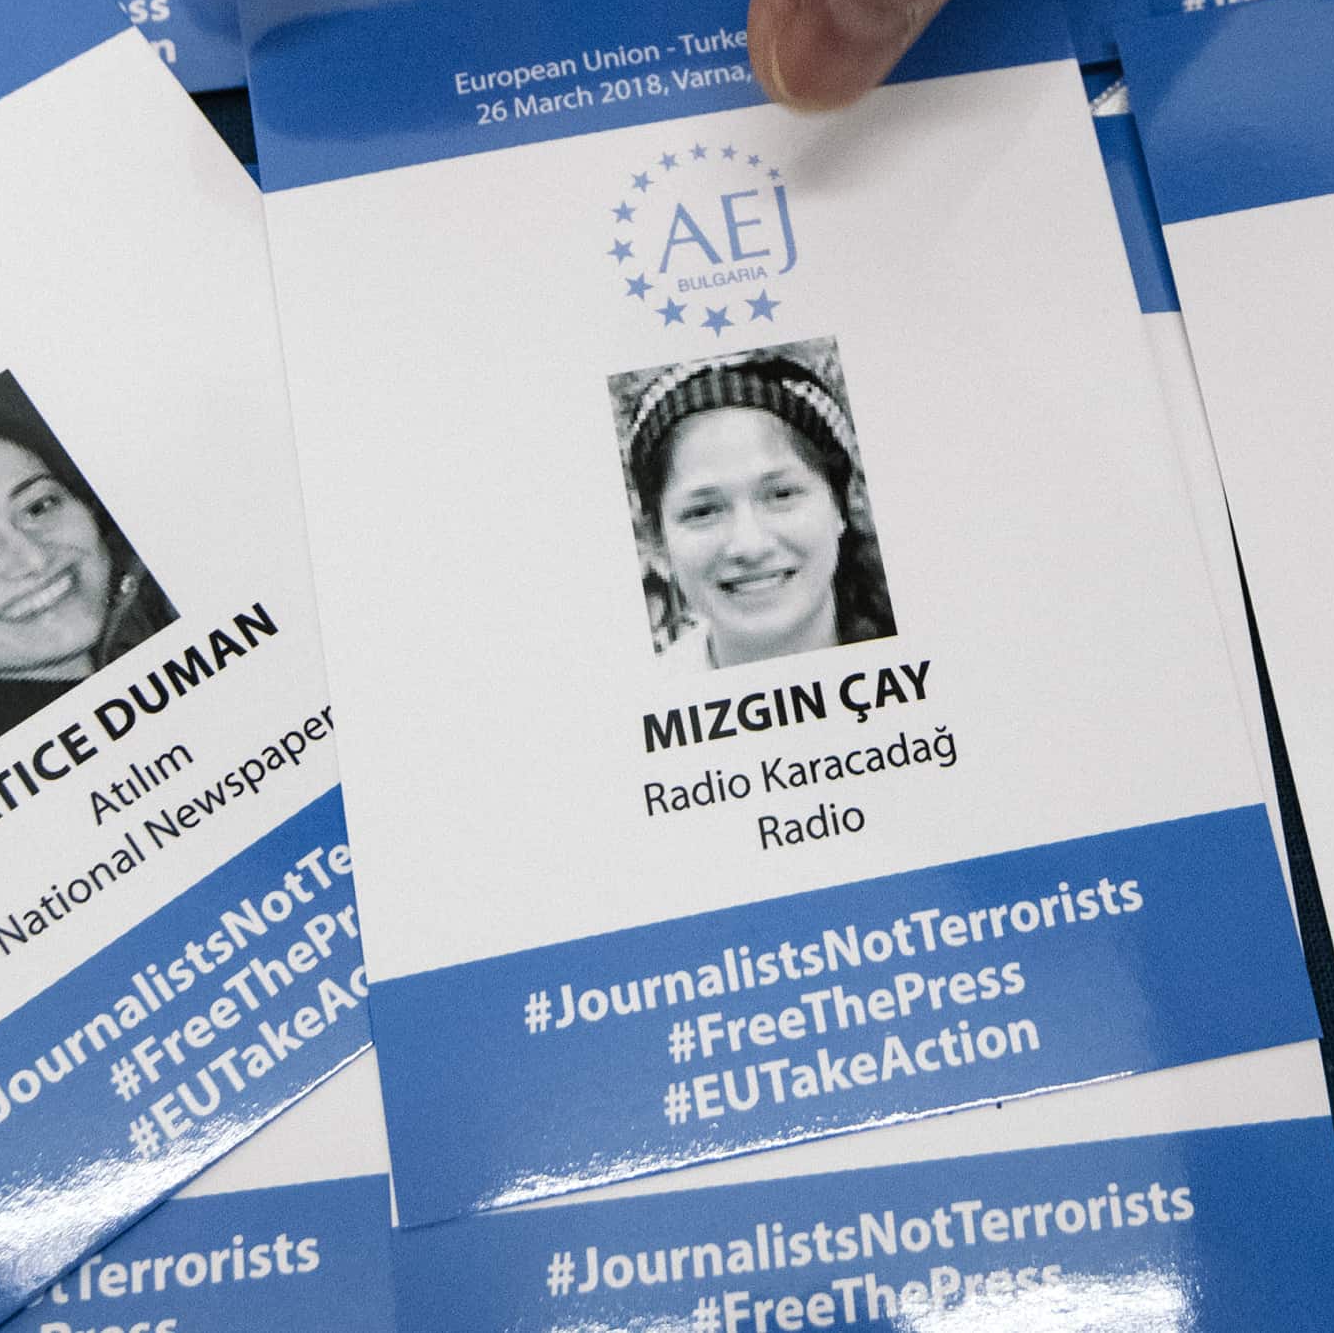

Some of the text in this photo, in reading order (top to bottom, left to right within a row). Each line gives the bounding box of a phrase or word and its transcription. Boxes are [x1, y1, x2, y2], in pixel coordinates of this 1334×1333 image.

[453, 57, 580, 94] European
[580, 42, 663, 72] Union
[680, 26, 744, 53] Turke
[474, 98, 510, 124] 26
[511, 85, 595, 118] March
[595, 74, 670, 104] 2018,
[658, 185, 798, 275] AEJ
[678, 266, 768, 292] BULGARIA
[94, 603, 278, 741] DUMAN
[643, 660, 930, 753] MIZGIN ÇAY
[90, 745, 193, 825] Atılım
[143, 706, 334, 849] Newspaper
[644, 725, 957, 816] Radio Karacadağ
[758, 803, 865, 850] Radio
[110, 904, 358, 1101] #FreeThePr
[525, 876, 1144, 1034] #JournalistsNotTerrorists
[669, 958, 1026, 1063] #FreeThePress
[128, 964, 369, 1161] #EUTakeAc
[664, 1013, 1040, 1125] #EUTakeAction
[547, 1181, 1195, 1296] #JournalistsNotTerrorists
